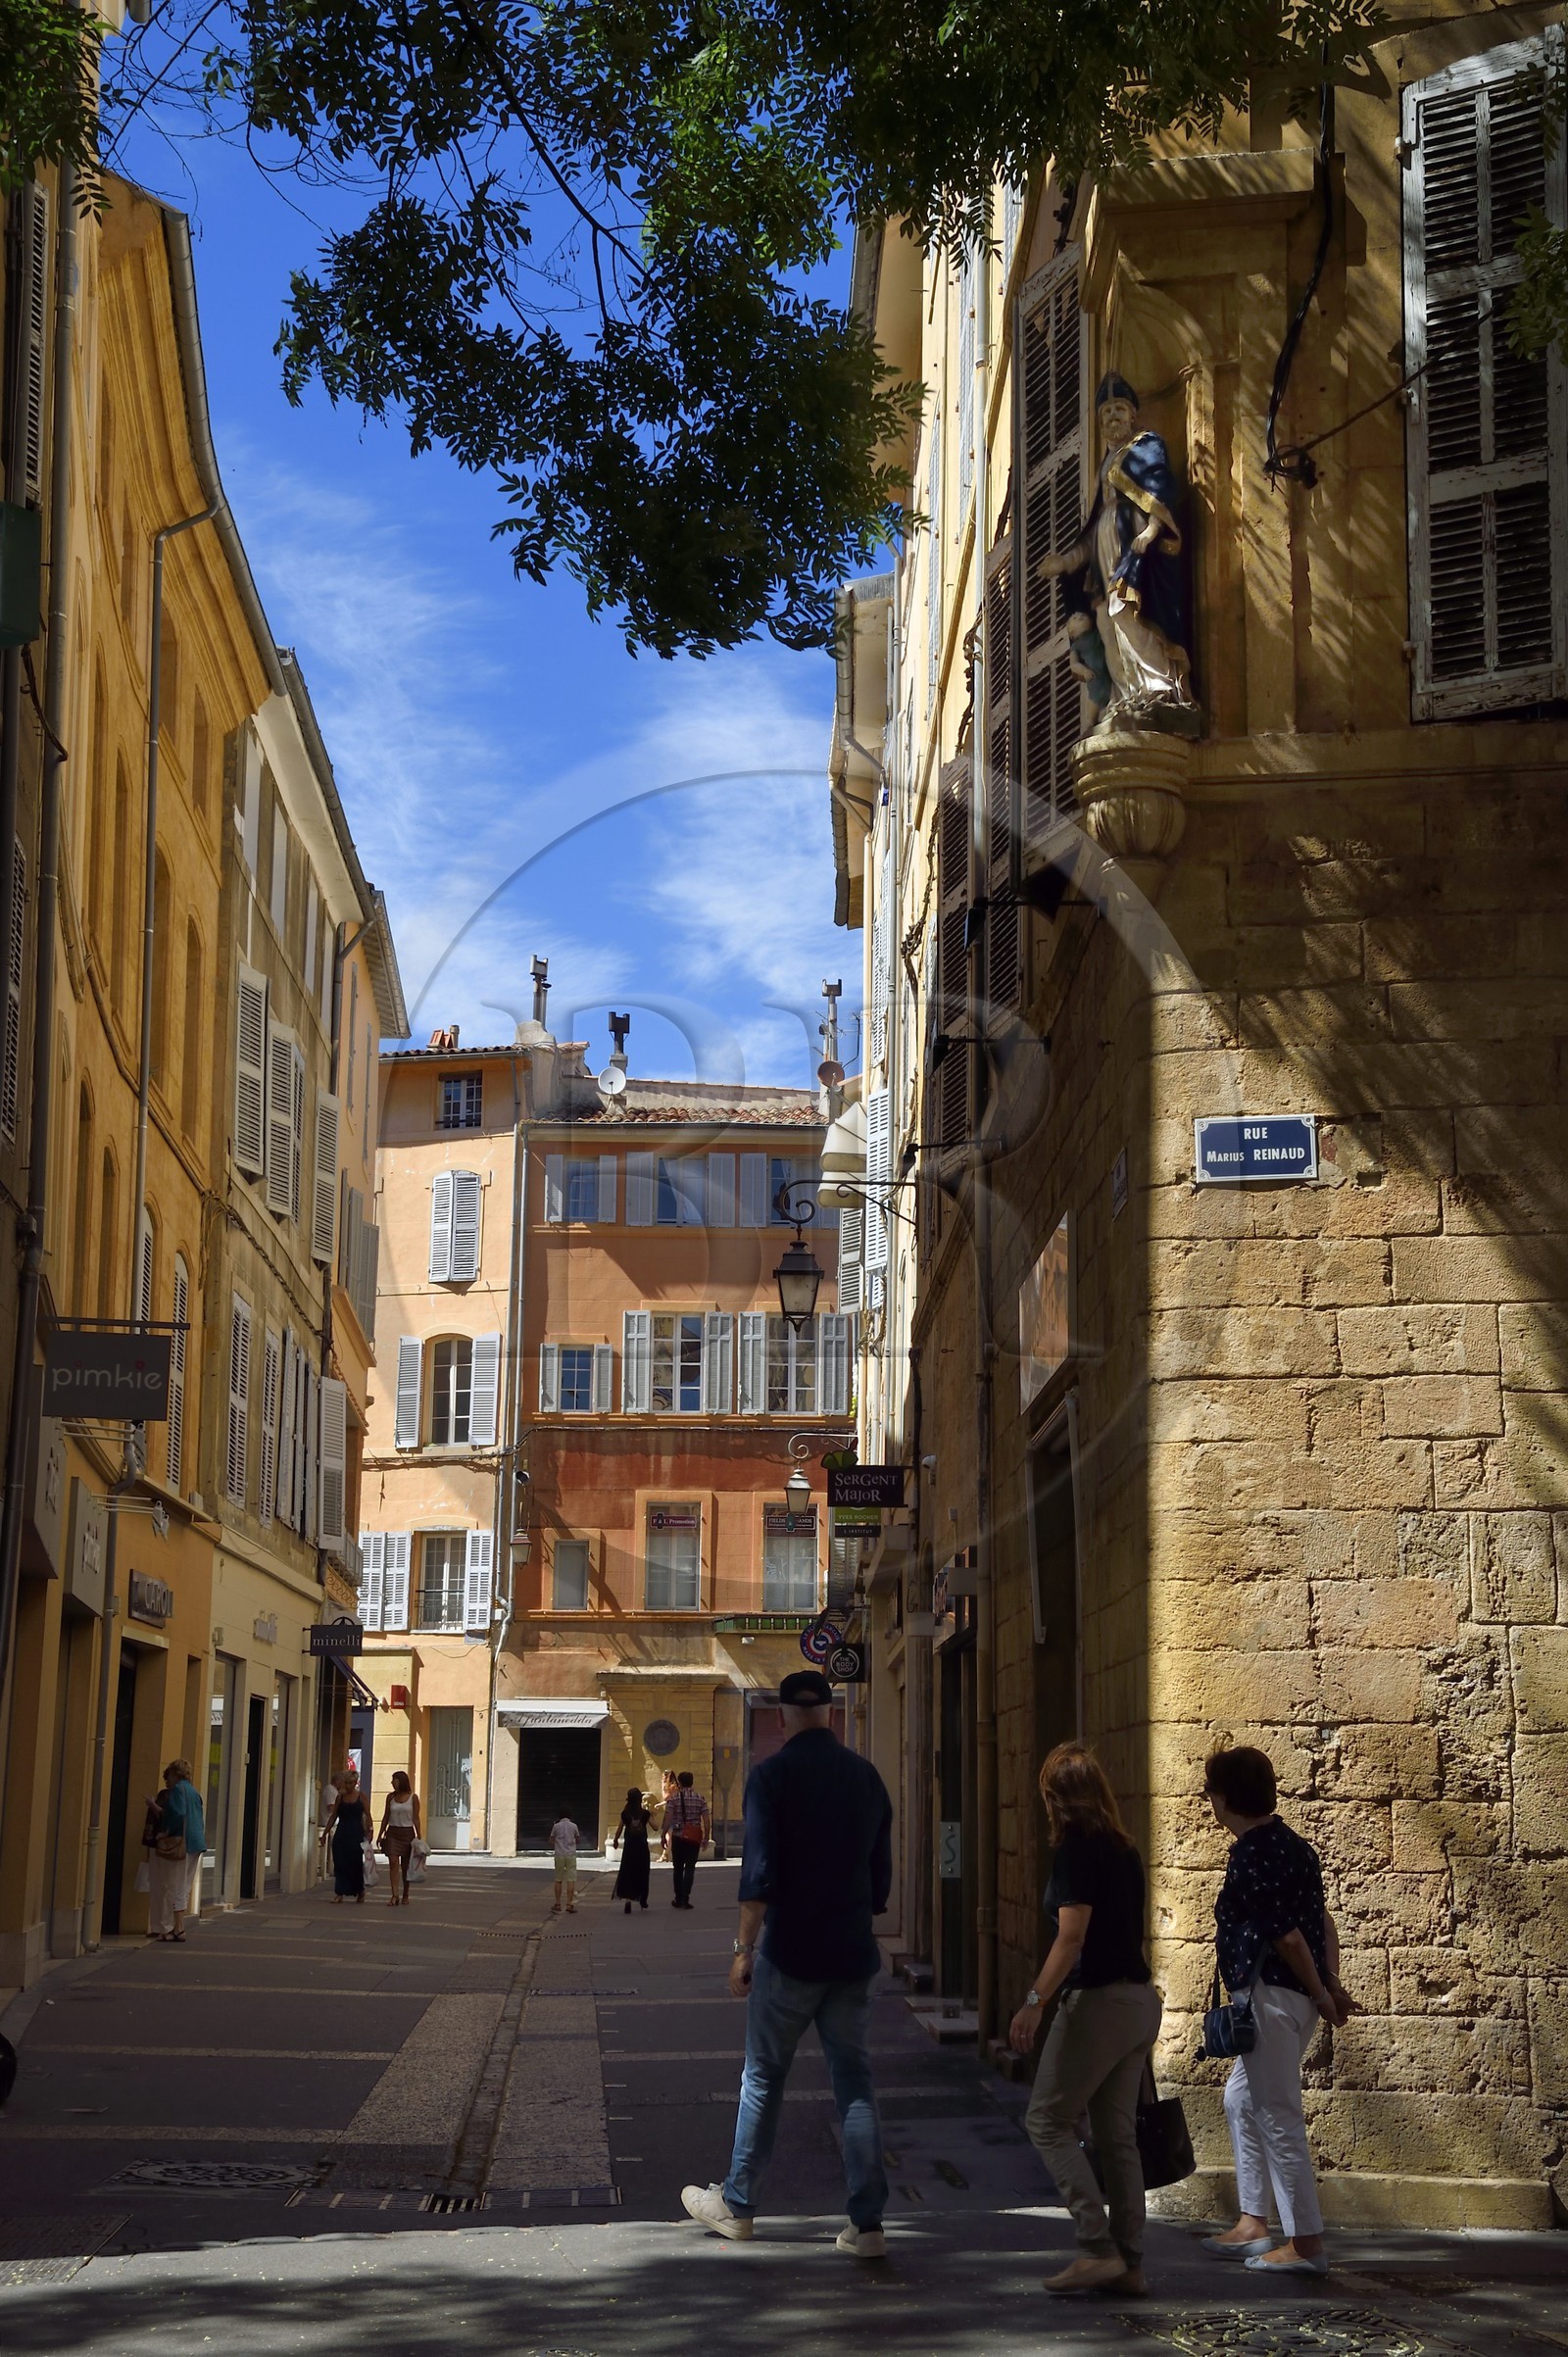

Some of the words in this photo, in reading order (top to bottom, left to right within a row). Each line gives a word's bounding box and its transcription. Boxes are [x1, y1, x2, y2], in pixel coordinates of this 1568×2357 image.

[1244, 1127, 1268, 1140] RUE
[1206, 1151, 1245, 1162] MARIUS
[1253, 1148, 1305, 1160] REINAUD
[52, 1359, 163, 1392] pimkie
[313, 1635, 361, 1646] minelli
